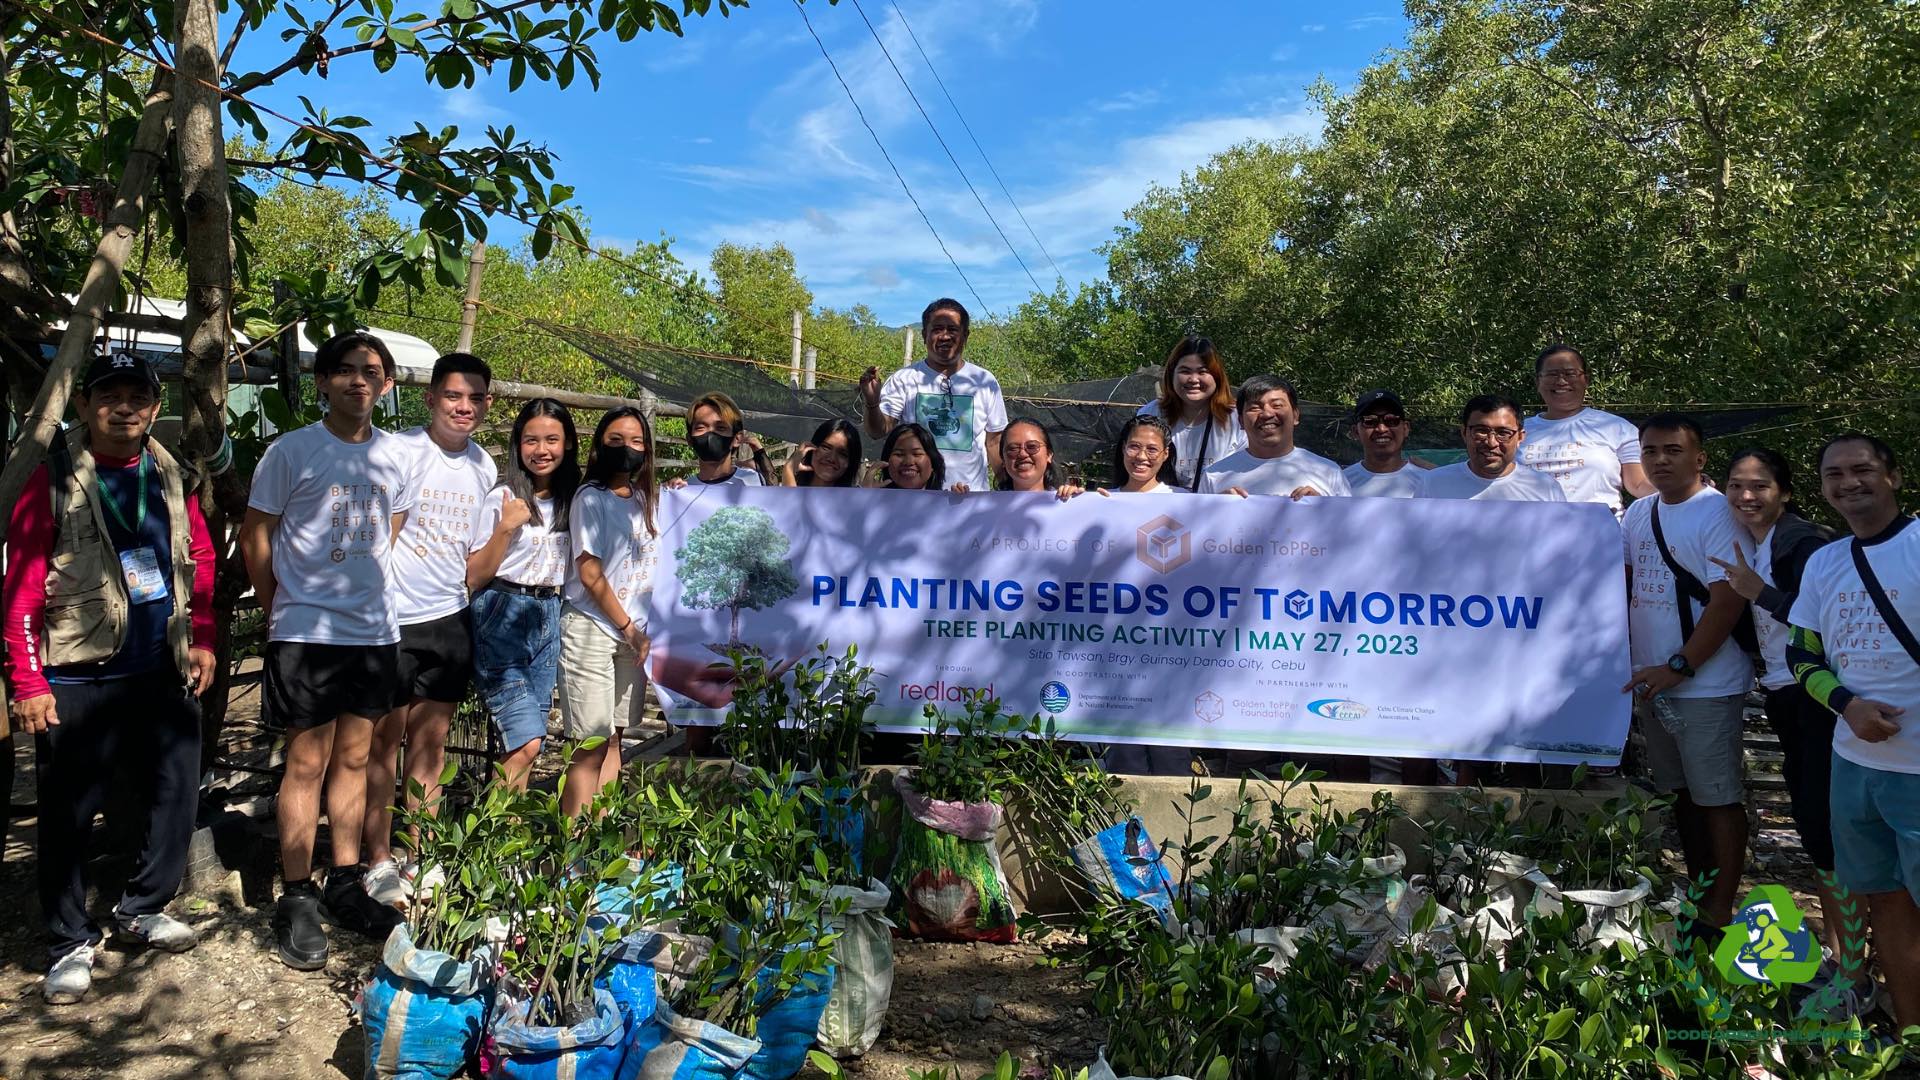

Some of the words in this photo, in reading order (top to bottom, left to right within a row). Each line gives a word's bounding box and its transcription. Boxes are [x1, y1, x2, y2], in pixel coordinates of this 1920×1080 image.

[110, 352, 135, 368] LA
[331, 484, 388, 497] BETTER
[422, 488, 476, 505] BETTER
[331, 499, 382, 513] CITIES
[420, 502, 469, 518] CITIES
[417, 516, 470, 533] BETTER
[331, 530, 375, 544] LIVES
[970, 538, 982, 551] A
[991, 537, 1082, 553] PROJECT
[1091, 539, 1117, 553] OF
[1202, 536, 1264, 556] Golden
[1269, 539, 1328, 557] ToPPer
[812, 575, 1024, 611] PLANTING
[1037, 581, 1170, 617] SEEDS
[1183, 585, 1241, 619] OF
[923, 619, 977, 639] TREE
[985, 621, 1105, 643] PLANTING
[1112, 624, 1226, 648] ACTIVITY
[1249, 630, 1307, 651] MAY
[1313, 632, 1348, 656] 27,
[1357, 633, 1419, 656] 2023
[1028, 648, 1053, 661] Sitio
[1057, 650, 1104, 664] Tawsan,
[1108, 652, 1136, 666] Brgy.
[1140, 653, 1190, 668] Guinsay
[1193, 656, 1235, 668] Danao
[1238, 657, 1265, 672] City,
[1271, 659, 1306, 671] Cebu
[1065, 670, 1124, 679] COOPERATION
[1126, 672, 1147, 680] WITH
[900, 680, 994, 702] redland
[1267, 679, 1324, 688] PARTNERSHIP
[1232, 699, 1266, 709] Golden
[1241, 709, 1291, 719] Foundation
